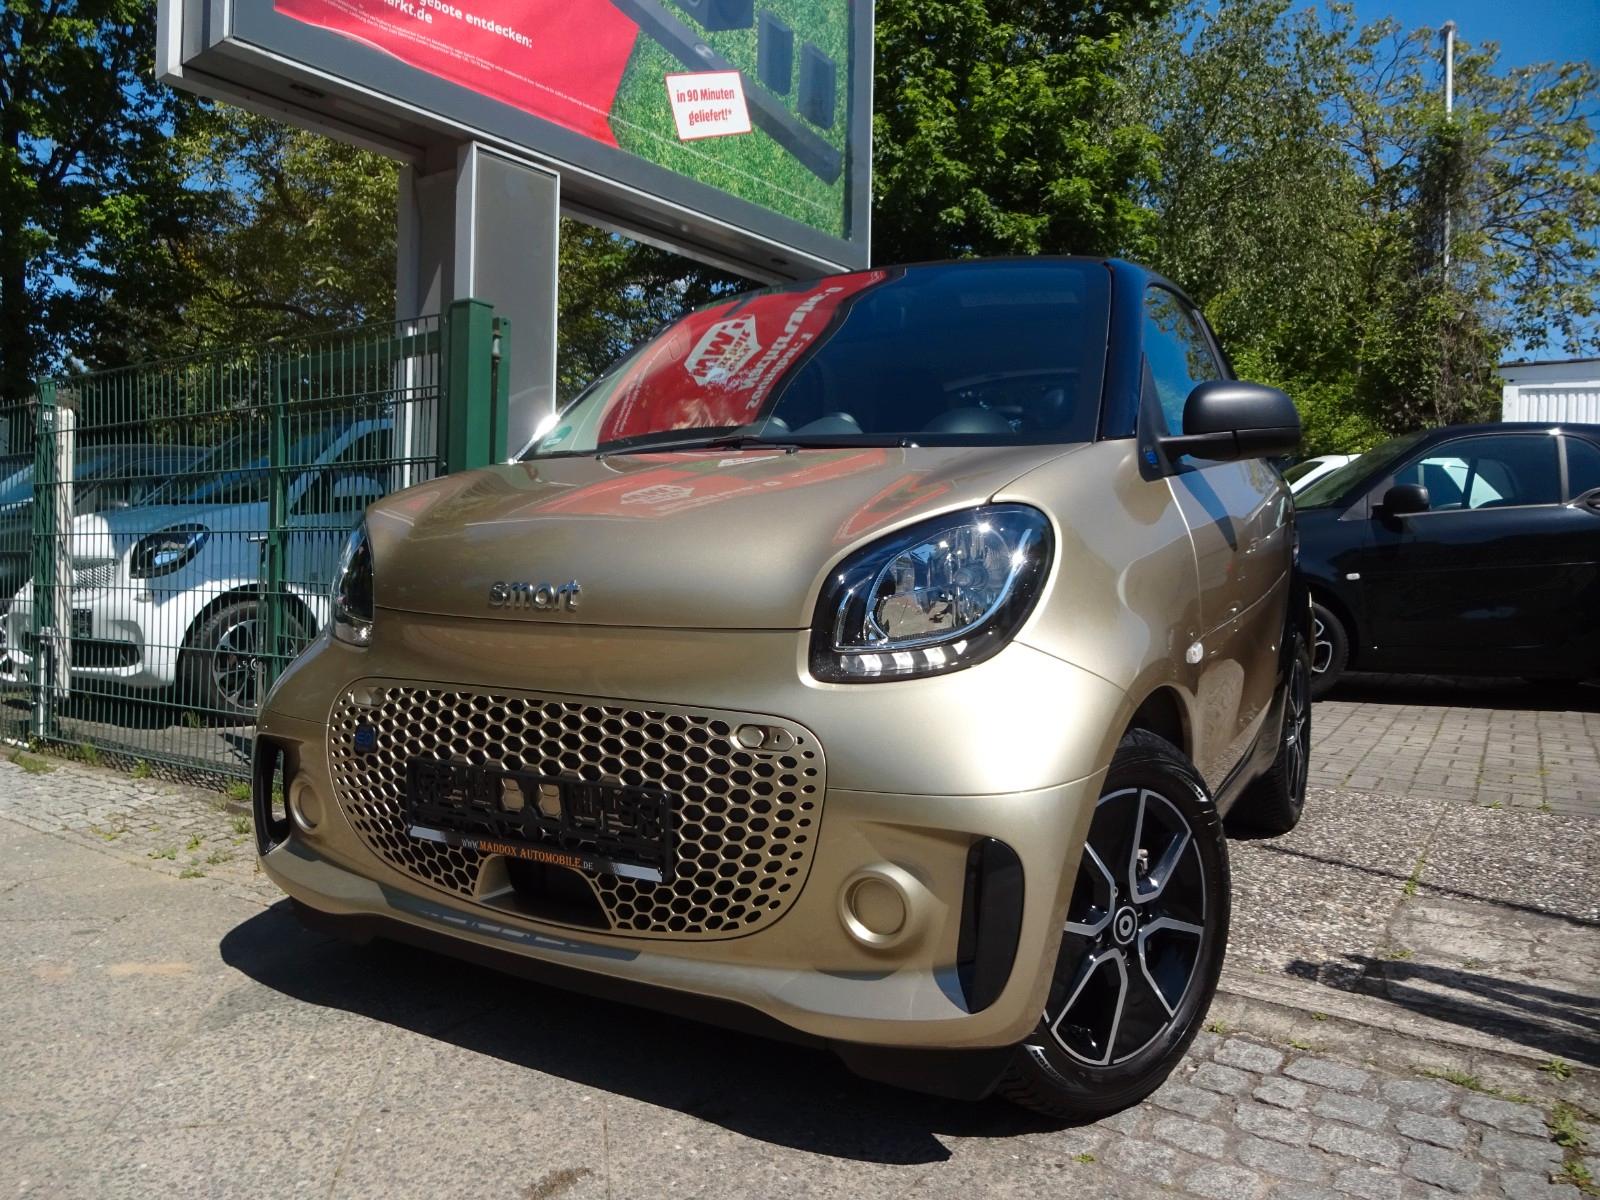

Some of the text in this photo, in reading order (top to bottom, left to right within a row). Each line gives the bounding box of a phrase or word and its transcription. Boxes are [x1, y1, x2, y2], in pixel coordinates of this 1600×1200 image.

[465, 13, 533, 48] entdecken:
[676, 87, 735, 103] in 90 Minuten
[489, 578, 582, 612] smart
